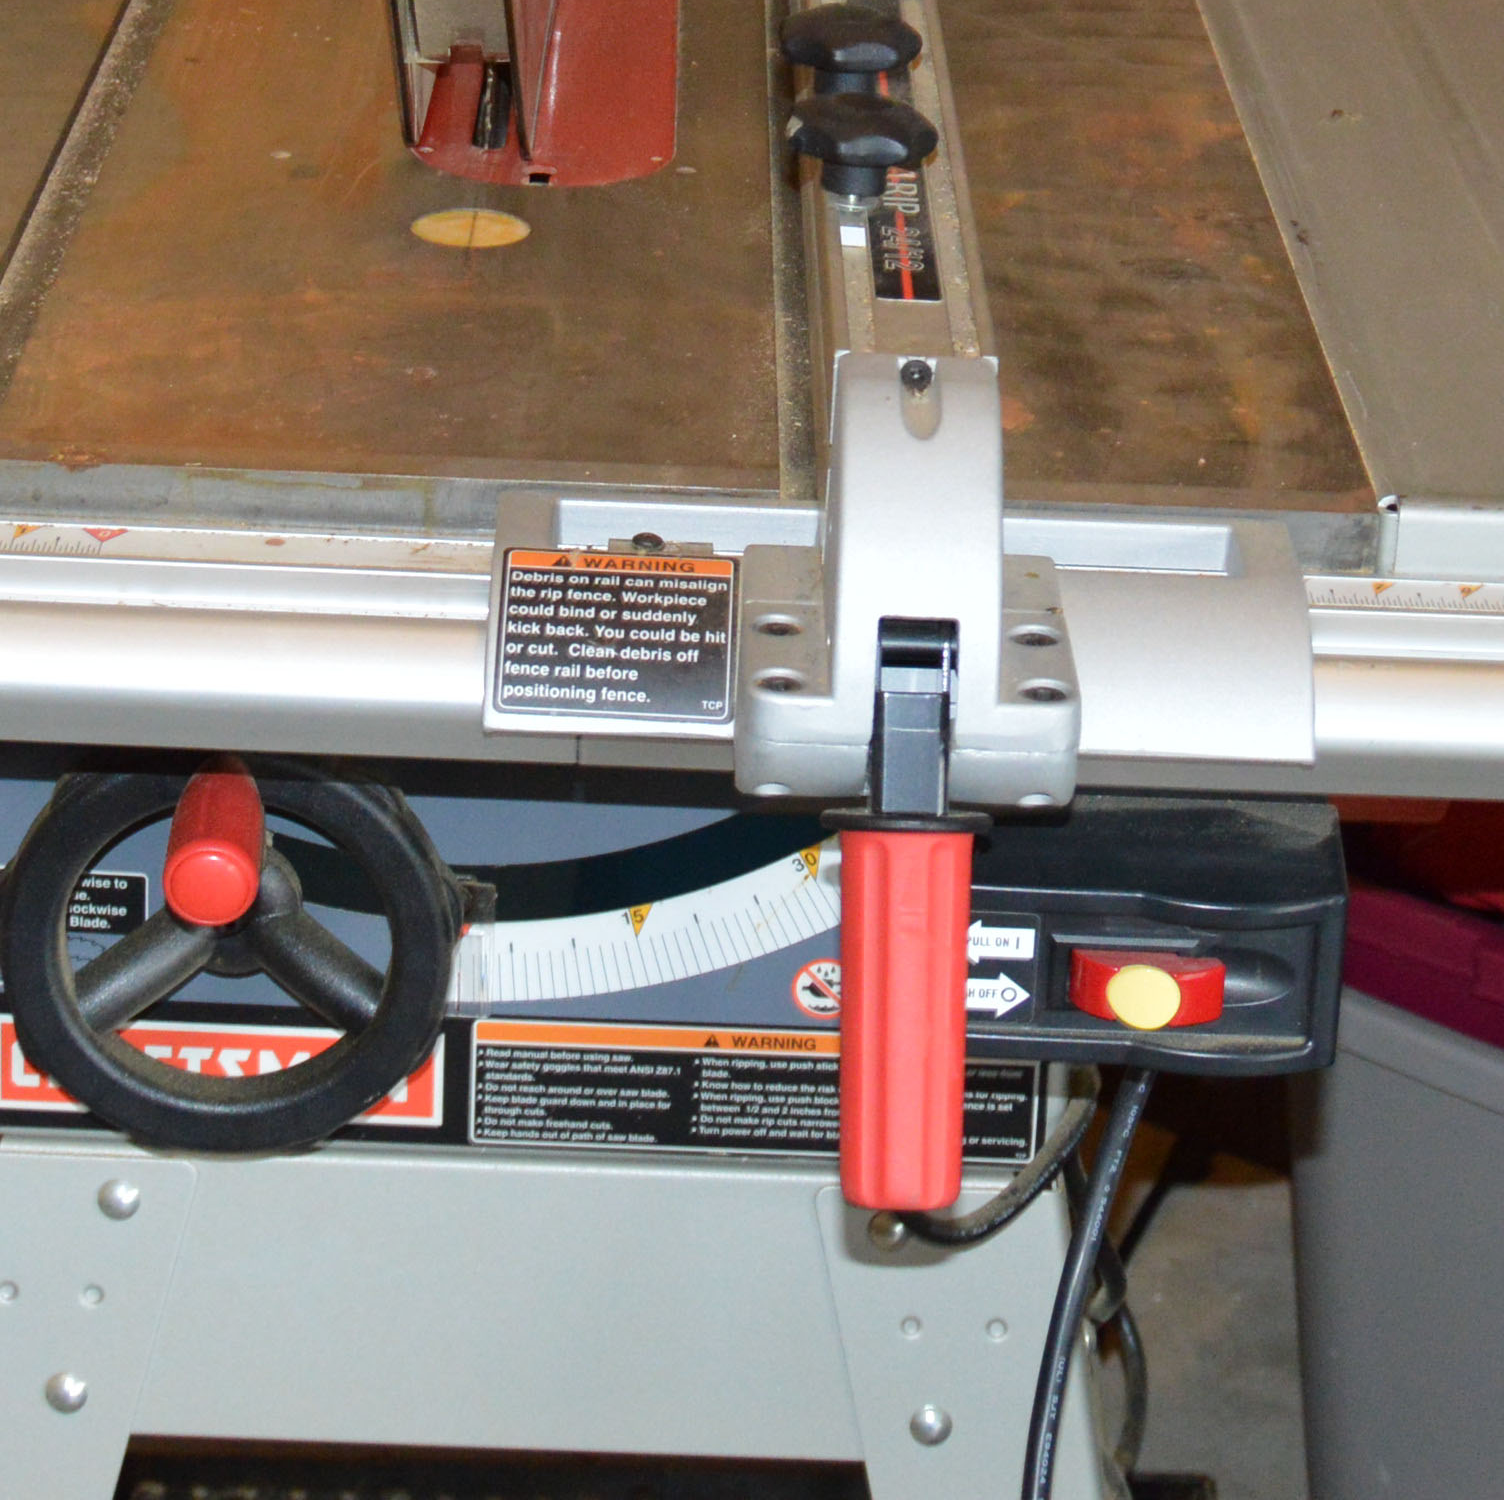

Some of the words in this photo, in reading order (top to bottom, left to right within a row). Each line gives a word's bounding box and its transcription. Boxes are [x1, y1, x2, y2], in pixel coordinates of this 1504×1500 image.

[584, 557, 695, 573] WARNING
[511, 571, 564, 583] Debris
[569, 575, 590, 584] on
[594, 575, 620, 586] rail
[625, 579, 654, 587] can
[659, 579, 728, 592] misalign
[510, 586, 536, 597] the
[540, 587, 563, 600] rip
[567, 589, 616, 602] fence.
[622, 591, 707, 607] Workpiece
[509, 604, 554, 616] could
[559, 606, 595, 618] bind
[600, 610, 617, 619] or
[622, 610, 697, 625] suddenly
[507, 621, 540, 635] kick
[546, 623, 590, 636] back.
[594, 626, 625, 639] You
[629, 627, 675, 641] could
[680, 631, 700, 642] be
[705, 631, 727, 644] hit
[506, 643, 524, 653] or
[528, 643, 559, 655] cut.
[569, 644, 616, 657] Clean
[620, 648, 672, 661] debris
[677, 649, 699, 663] off
[504, 661, 549, 676] fence
[554, 664, 581, 677] rail
[586, 665, 638, 681] before
[503, 684, 597, 703] positioning
[601, 687, 651, 703] fence.
[702, 700, 723, 710] TCP
[792, 852, 817, 872] 30
[114, 879, 127, 889] to
[70, 916, 111, 928] Blade.
[621, 909, 644, 924] 15
[995, 936, 1009, 947] ON
[979, 988, 998, 998] OFF
[732, 1036, 816, 1050] WARNING
[486, 1049, 511, 1058] Read
[513, 1050, 548, 1058] manual
[550, 1052, 581, 1060] before
[583, 1054, 610, 1063] using
[485, 1060, 509, 1068] Wear
[511, 1061, 541, 1072] safety
[542, 1063, 581, 1073] goggles
[583, 1064, 601, 1073] that
[604, 1065, 627, 1073] meet
[629, 1066, 654, 1074] ANSI
[656, 1067, 681, 1076] Z87.1
[702, 1057, 729, 1066] When
[790, 1062, 814, 1071] push
[485, 1083, 498, 1091] Do
[501, 1084, 517, 1092] not
[519, 1085, 545, 1093] reach
[548, 1086, 582, 1094] around
[620, 1089, 639, 1097] saw
[702, 1080, 729, 1089] Know
[731, 1082, 751, 1090] how
[753, 1082, 763, 1091] to
[765, 1083, 798, 1093] reduce
[800, 1084, 816, 1093] the
[818, 1085, 836, 1093] risk
[485, 1094, 509, 1105] Keep
[512, 1095, 537, 1104] blade
[540, 1097, 567, 1106] guard
[569, 1097, 596, 1107] down
[598, 1099, 616, 1107] and
[629, 1101, 655, 1110] place
[658, 1101, 671, 1110] for
[701, 1092, 727, 1100] When
[484, 1106, 522, 1116] through
[701, 1103, 740, 1112] between
[762, 1106, 780, 1114] and
[790, 1107, 821, 1116] inches
[484, 1117, 497, 1126] Do
[500, 1117, 515, 1126] not
[518, 1118, 544, 1127] make
[546, 1118, 589, 1129] freehand
[701, 1114, 714, 1123] Do
[716, 1115, 731, 1124] not
[734, 1117, 760, 1125] make
[762, 1118, 775, 1126] rip
[777, 1117, 798, 1126] cuts
[484, 1128, 508, 1138] Keep
[511, 1129, 539, 1138] hands
[542, 1130, 557, 1139] out
[560, 1131, 570, 1139] of
[572, 1131, 593, 1141] path
[595, 1132, 606, 1141] of
[608, 1133, 627, 1141] saw
[699, 1126, 720, 1135] Turn
[722, 1128, 751, 1137] power
[753, 1128, 767, 1137] off
[769, 1128, 787, 1137] and
[789, 1129, 808, 1138] wait
[811, 1130, 824, 1139] for
